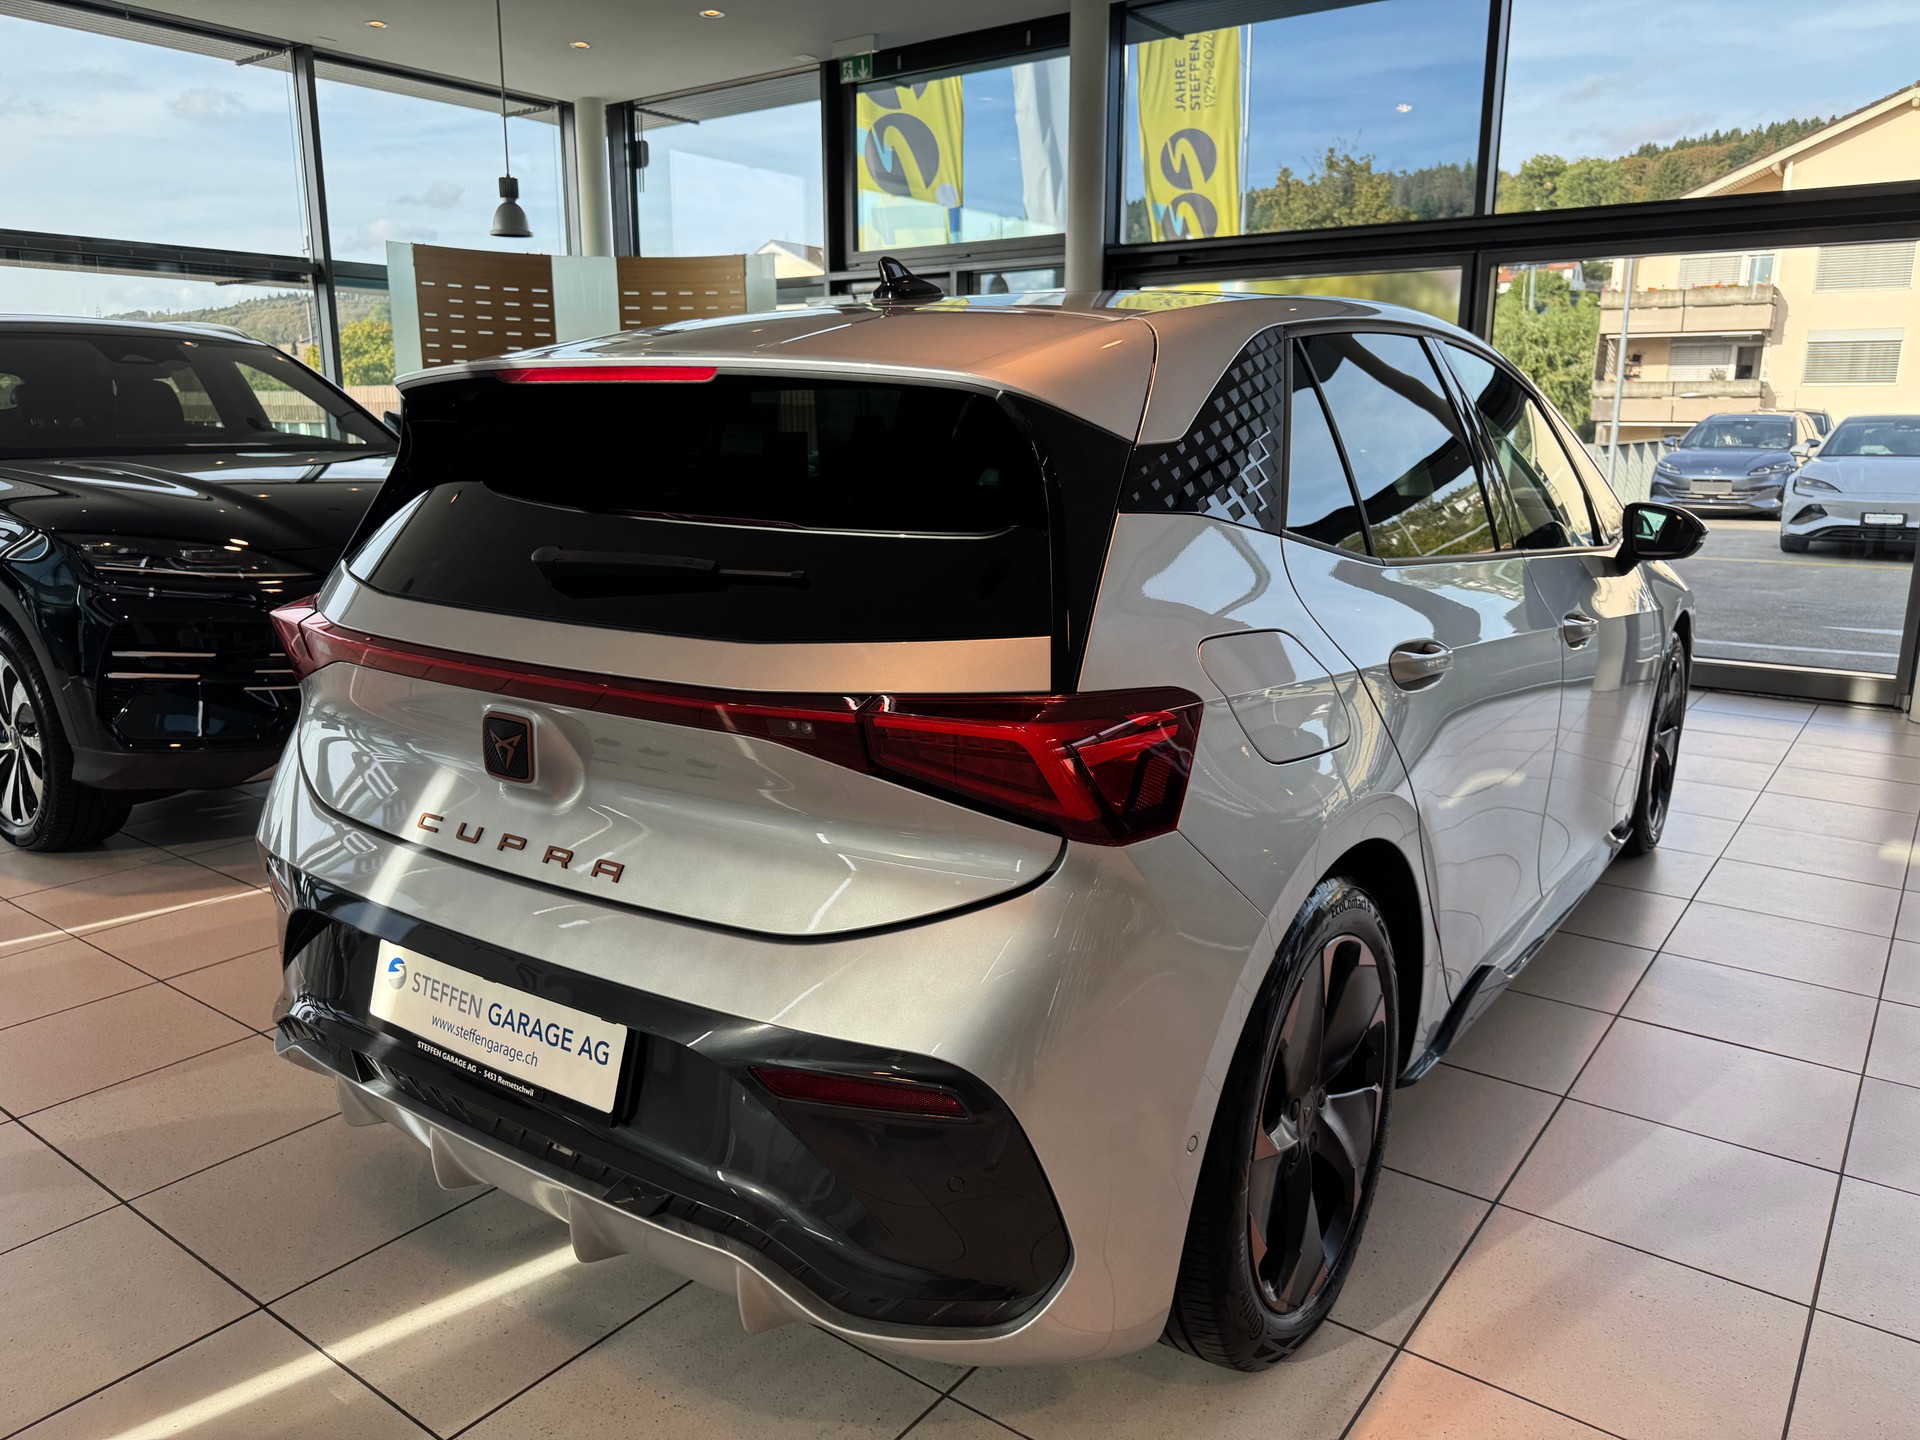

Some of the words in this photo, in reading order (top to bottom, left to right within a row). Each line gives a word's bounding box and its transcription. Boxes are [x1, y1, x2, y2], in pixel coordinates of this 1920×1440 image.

[1175, 58, 1186, 112] JAHRE
[1189, 39, 1201, 111] STEFFEN
[417, 812, 625, 884] CUPRA
[411, 972, 483, 1019] STEFFEN
[488, 1003, 574, 1053] GARAGE
[577, 1036, 610, 1066] AG
[432, 1015, 538, 1067] www.steffengarage.ch
[417, 1040, 442, 1058] STEFFEN
[442, 1051, 467, 1070] GARAGE
[467, 1061, 477, 1073] AG
[484, 1070, 497, 1082] 5453
[497, 1075, 535, 1097] Remetschwil
